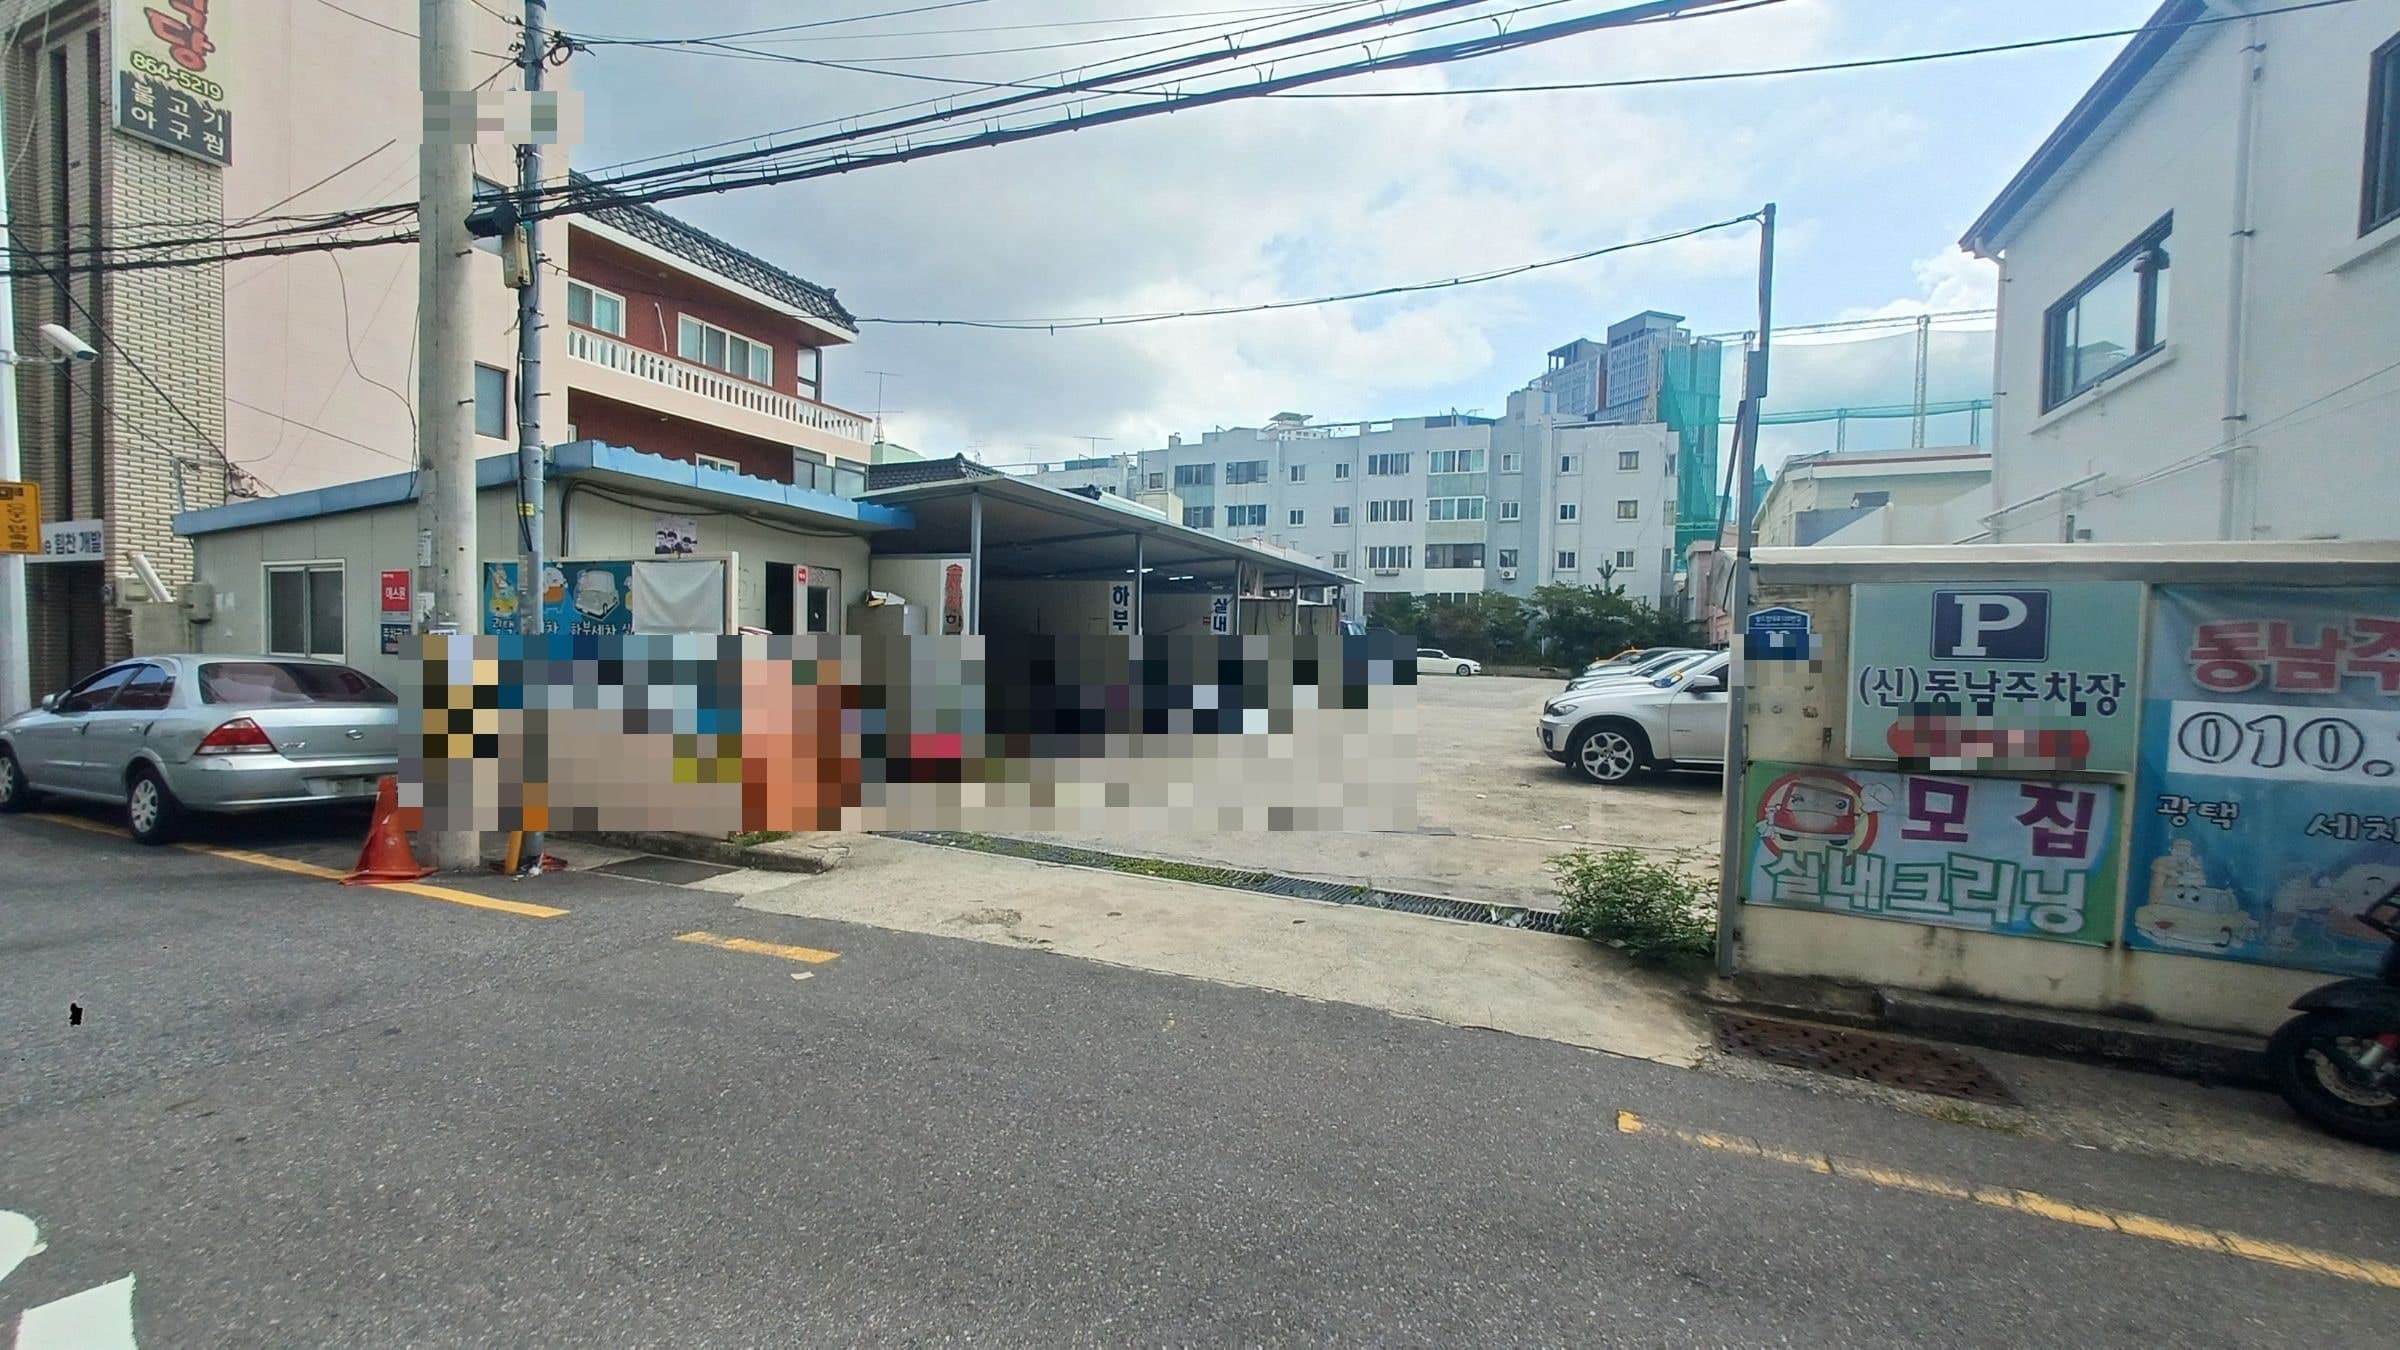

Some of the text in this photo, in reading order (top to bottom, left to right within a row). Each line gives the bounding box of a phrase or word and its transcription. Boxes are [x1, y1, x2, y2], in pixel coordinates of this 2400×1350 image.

[131, 51, 223, 101] 864-5219
[571, 621, 617, 636] 하부세차
[1112, 585, 1130, 632] 하부
[1213, 598, 1228, 632] 실내
[1951, 594, 2028, 657] P
[2189, 617, 2400, 693] 동남주
[1859, 666, 2126, 716] (신)동남주차장
[2177, 711, 2400, 777] 010.
[2158, 795, 2239, 829] 광택
[1761, 846, 2089, 934] 실내크리닝
